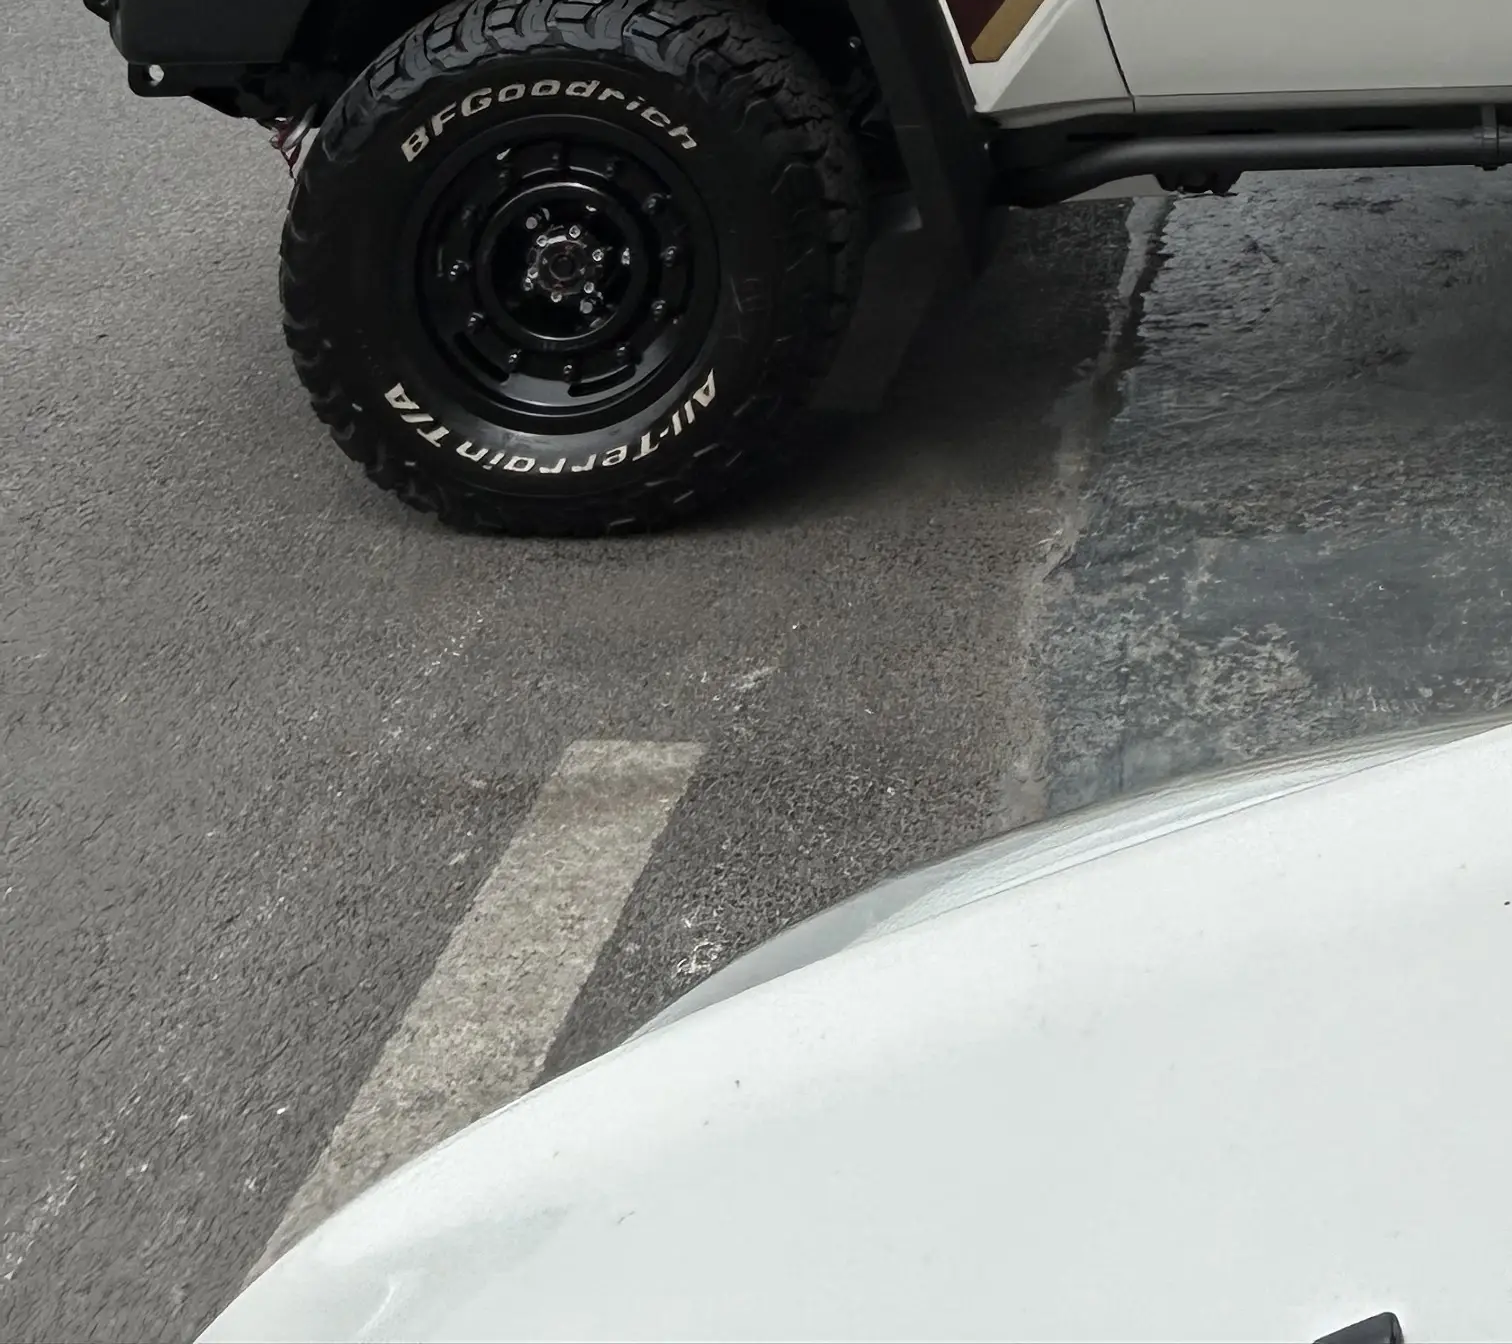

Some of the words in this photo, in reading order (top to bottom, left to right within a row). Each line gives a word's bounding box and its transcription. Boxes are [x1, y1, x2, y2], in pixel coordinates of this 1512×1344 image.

[400, 78, 698, 163] BFGoodrich
[383, 381, 450, 448] T/A
[455, 367, 717, 475] All-Terrain
